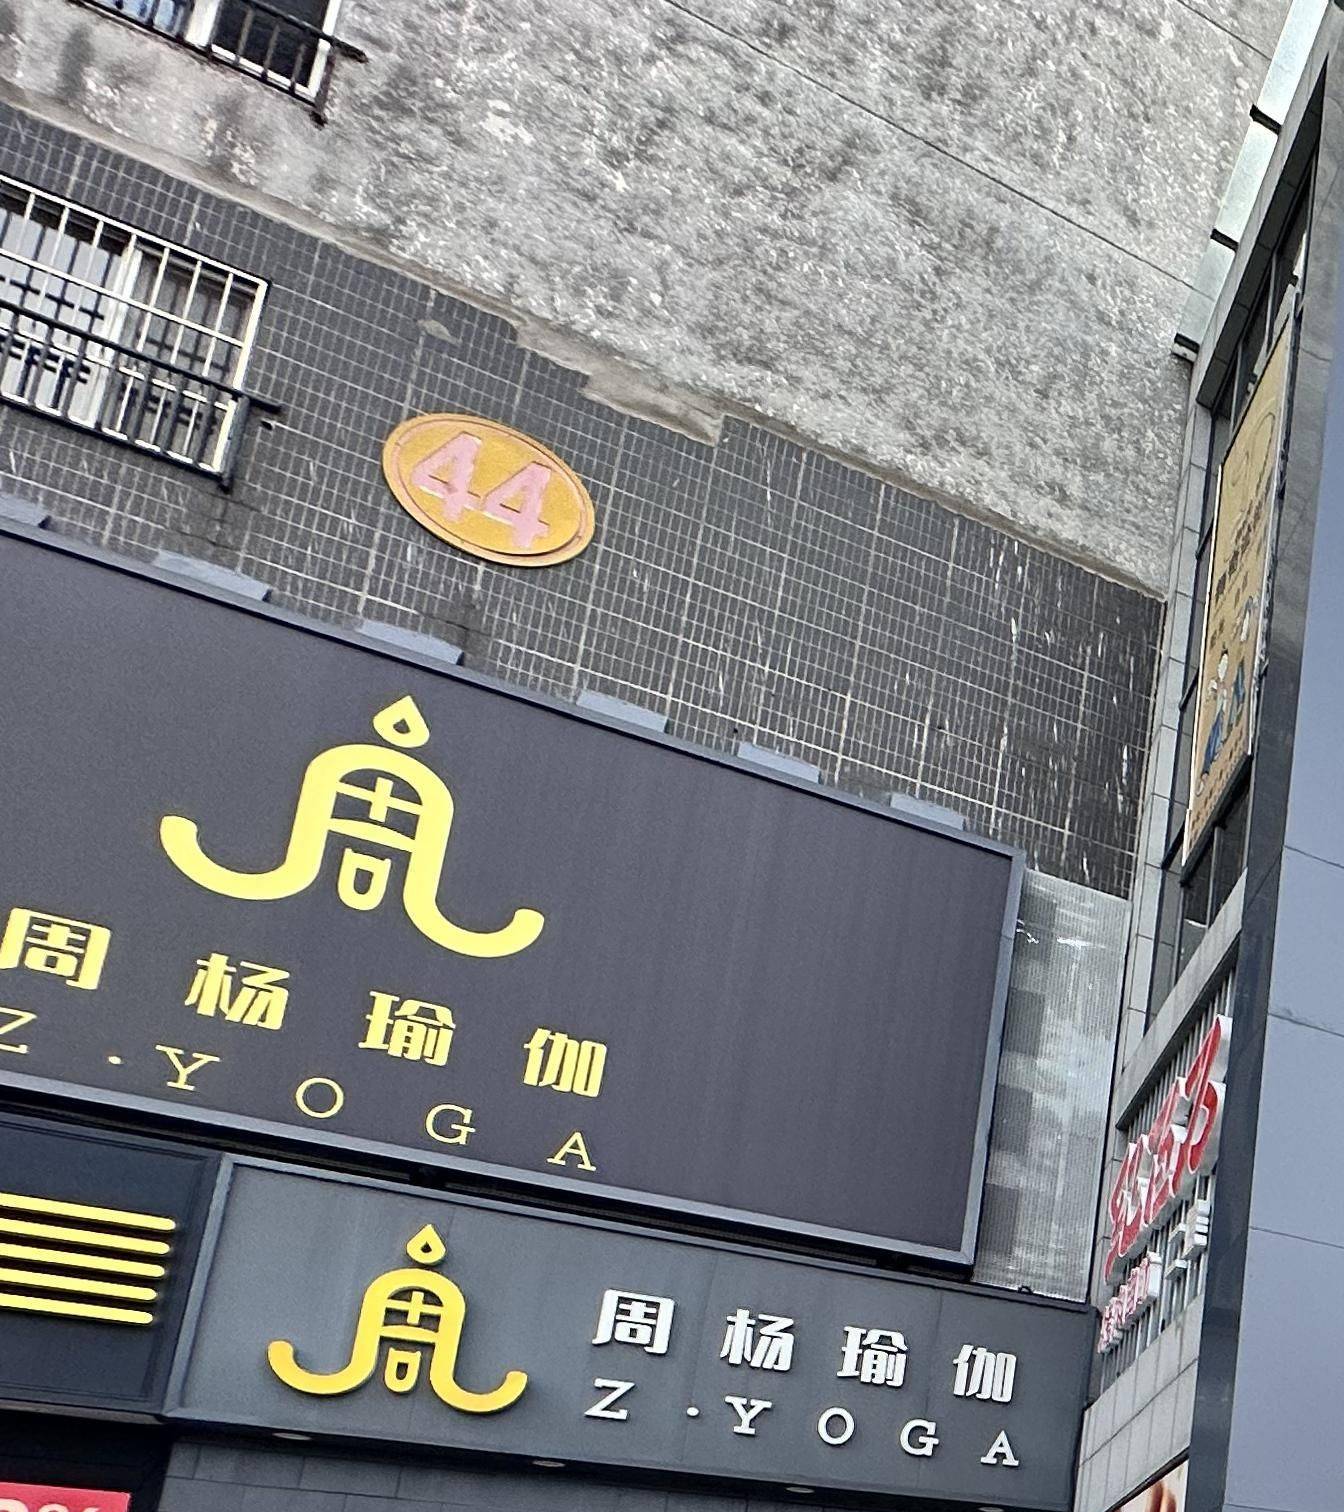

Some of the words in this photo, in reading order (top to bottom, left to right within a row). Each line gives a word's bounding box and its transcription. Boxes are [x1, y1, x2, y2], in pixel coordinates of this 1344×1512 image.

[412, 430, 552, 548] 44
[0, 907, 608, 1098] 周杨瑜伽
[592, 1288, 1018, 1405] 周杨瑜伽
